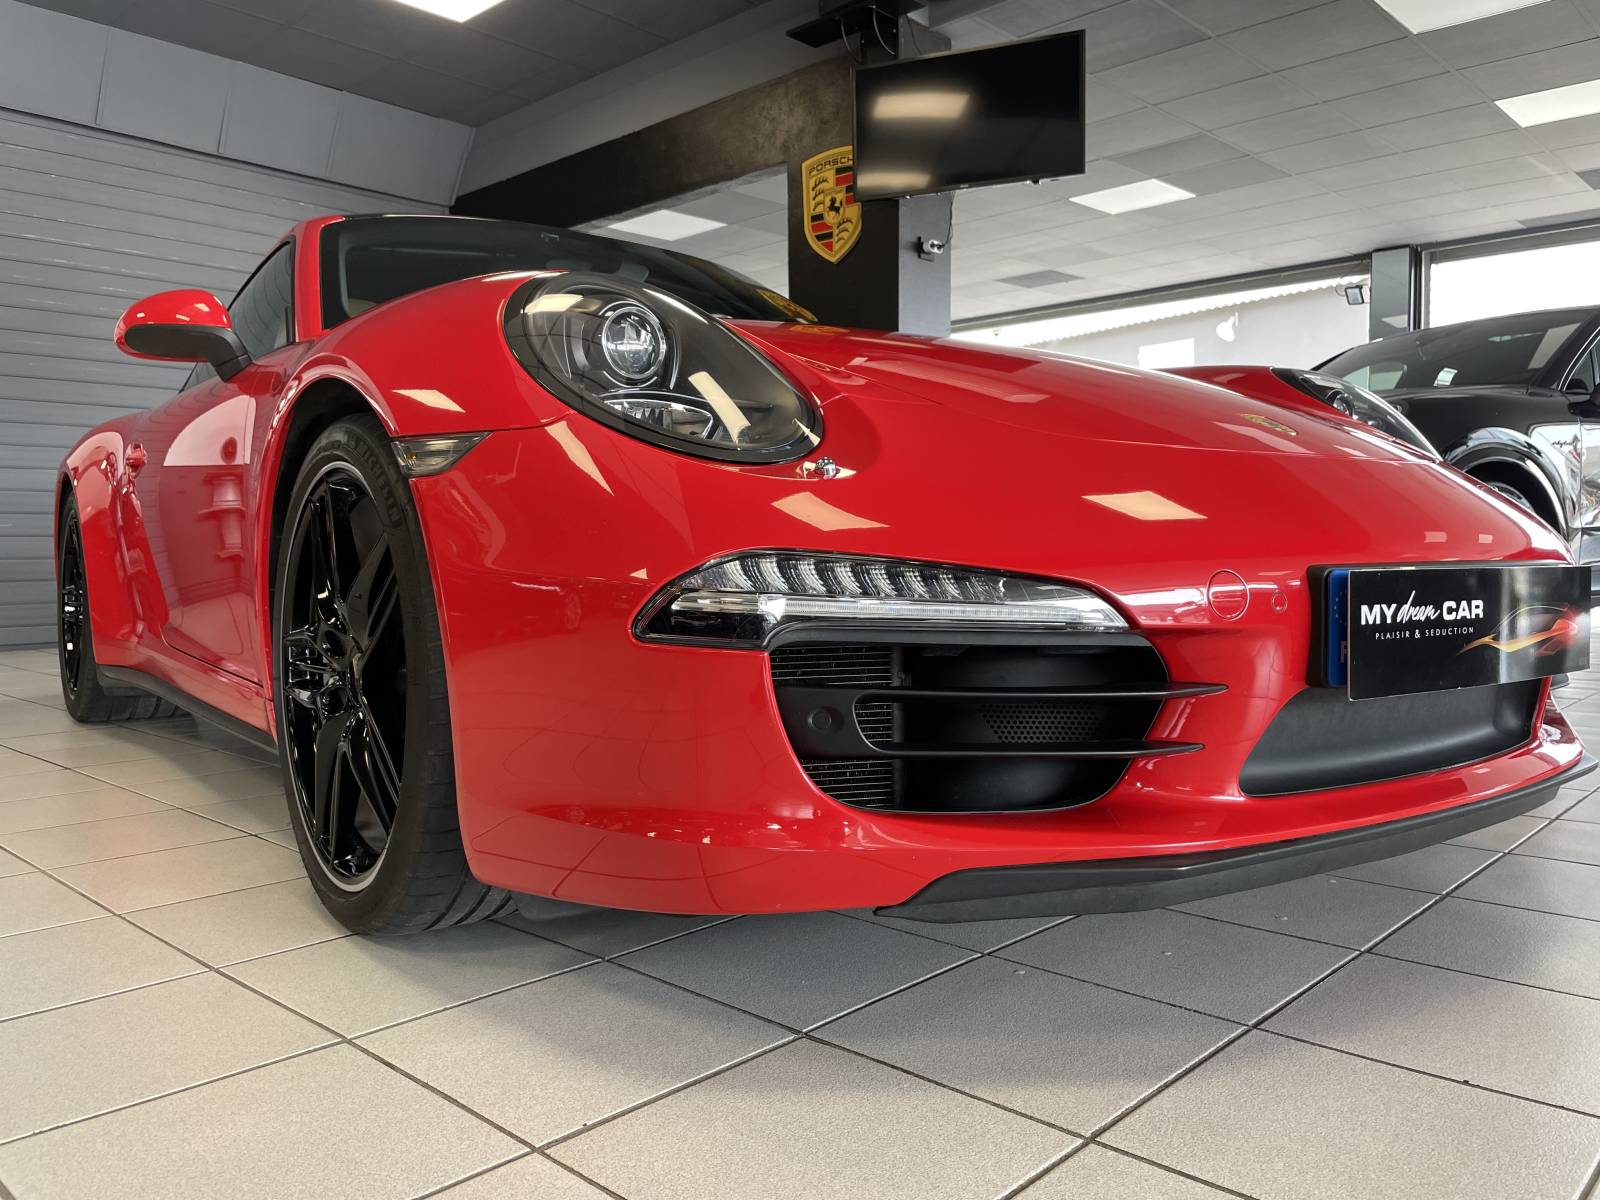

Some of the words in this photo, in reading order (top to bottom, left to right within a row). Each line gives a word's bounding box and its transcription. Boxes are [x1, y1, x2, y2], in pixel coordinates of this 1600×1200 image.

[808, 156, 853, 174] PORSCH
[1361, 604, 1397, 625] MY
[1397, 590, 1440, 624] dream
[1443, 600, 1484, 620] CAR
[1375, 631, 1410, 640] PLAISIR
[1414, 629, 1421, 639] &
[1425, 626, 1474, 637] SEDUCTION
